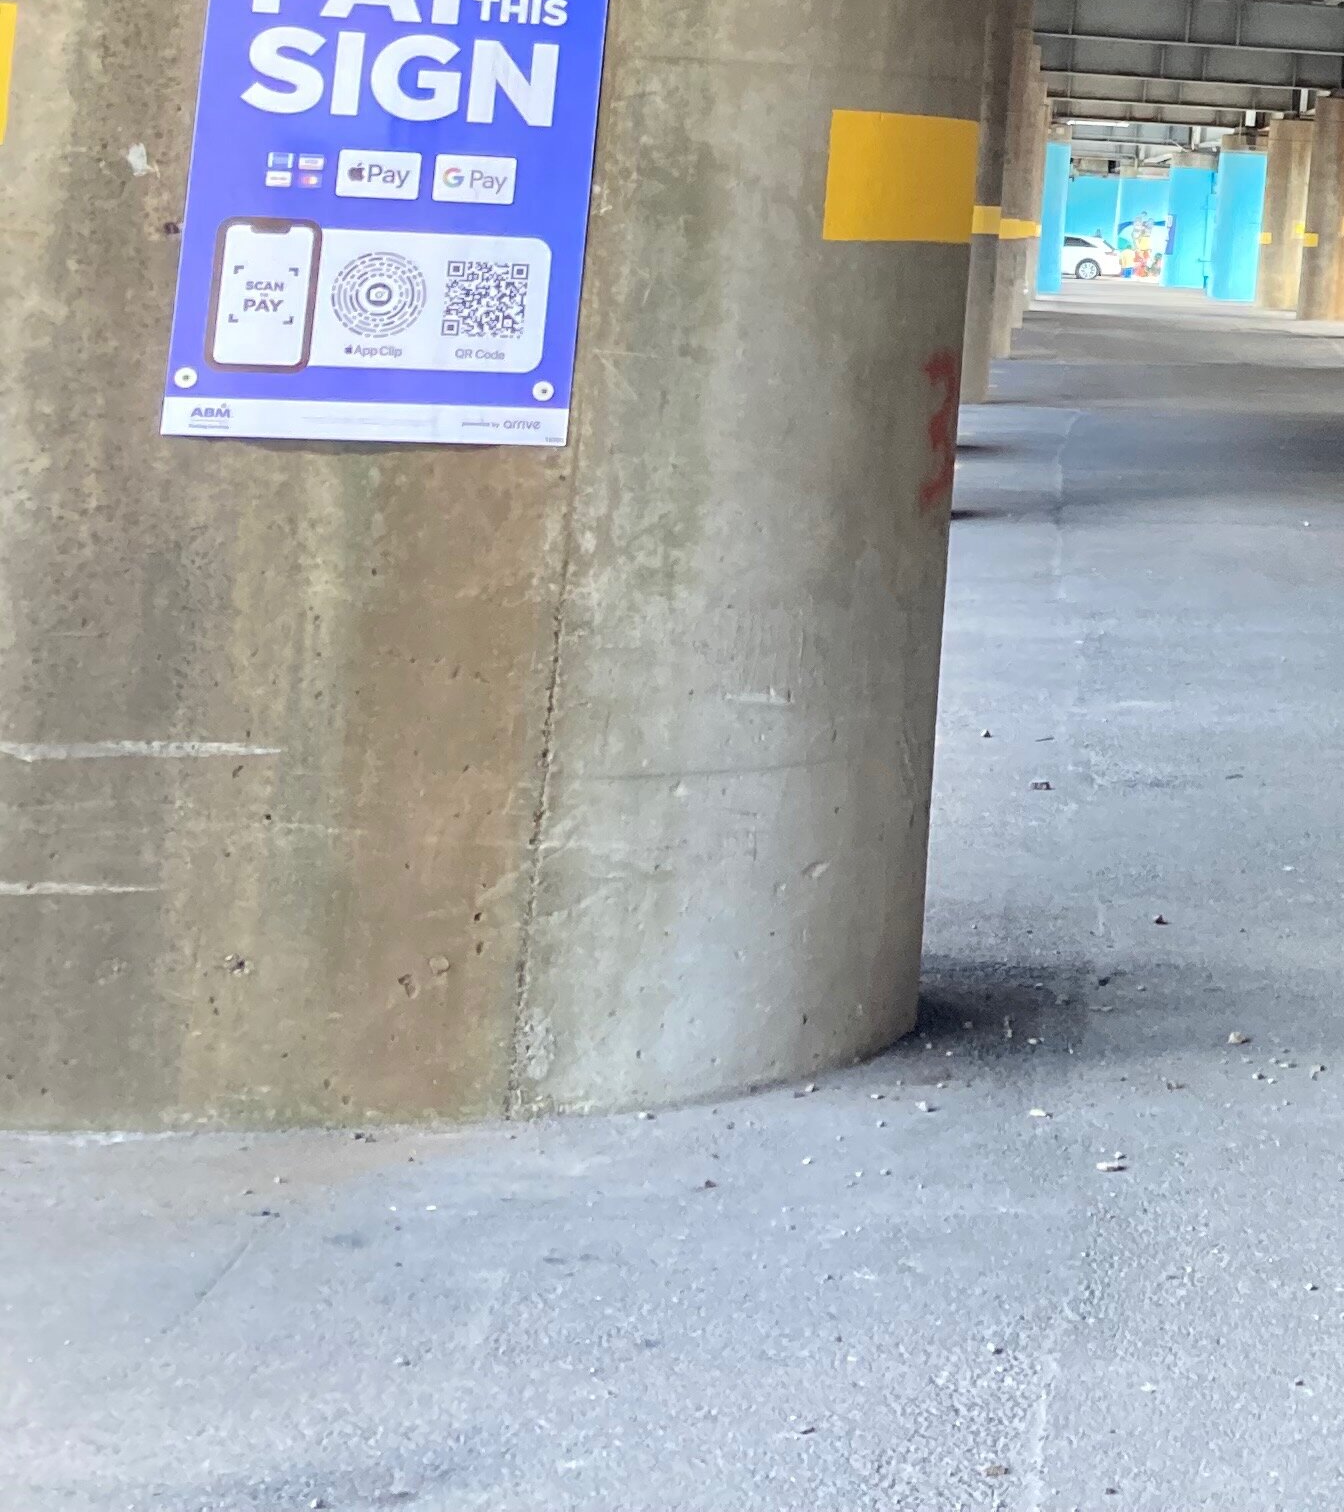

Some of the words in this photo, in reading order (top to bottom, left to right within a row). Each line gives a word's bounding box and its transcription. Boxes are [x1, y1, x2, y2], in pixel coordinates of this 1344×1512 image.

[240, 26, 560, 127] SIGN
[367, 164, 410, 189] Pay
[469, 169, 508, 195] Pay
[245, 280, 285, 292] SCAN
[243, 298, 285, 313] PAY
[353, 344, 378, 358] App
[379, 345, 403, 359] Clip
[454, 348, 473, 360] QR
[474, 349, 506, 361] Code
[190, 406, 232, 419] ABM
[503, 419, 542, 431] arrive
